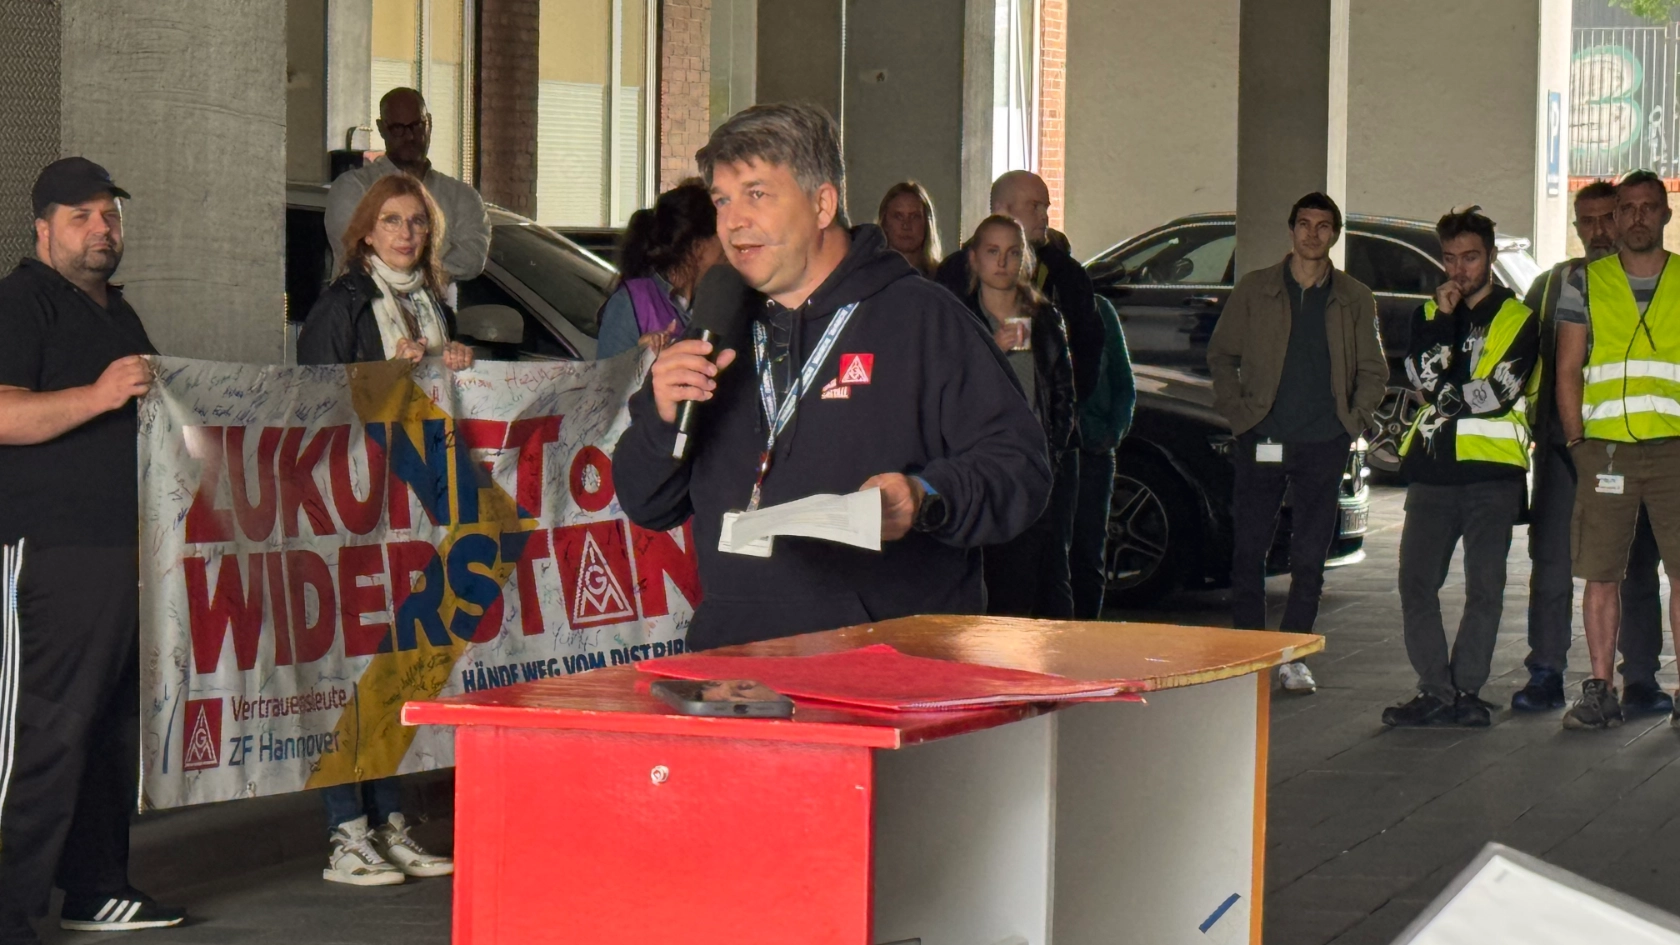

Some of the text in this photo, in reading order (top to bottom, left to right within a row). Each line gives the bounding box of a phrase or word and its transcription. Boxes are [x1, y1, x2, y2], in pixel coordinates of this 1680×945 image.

[183, 414, 564, 544] ZUKUNFT
[562, 652, 606, 675] VOM
[611, 638, 690, 667] DISTRIB
[228, 730, 340, 766] ZF Hannover
